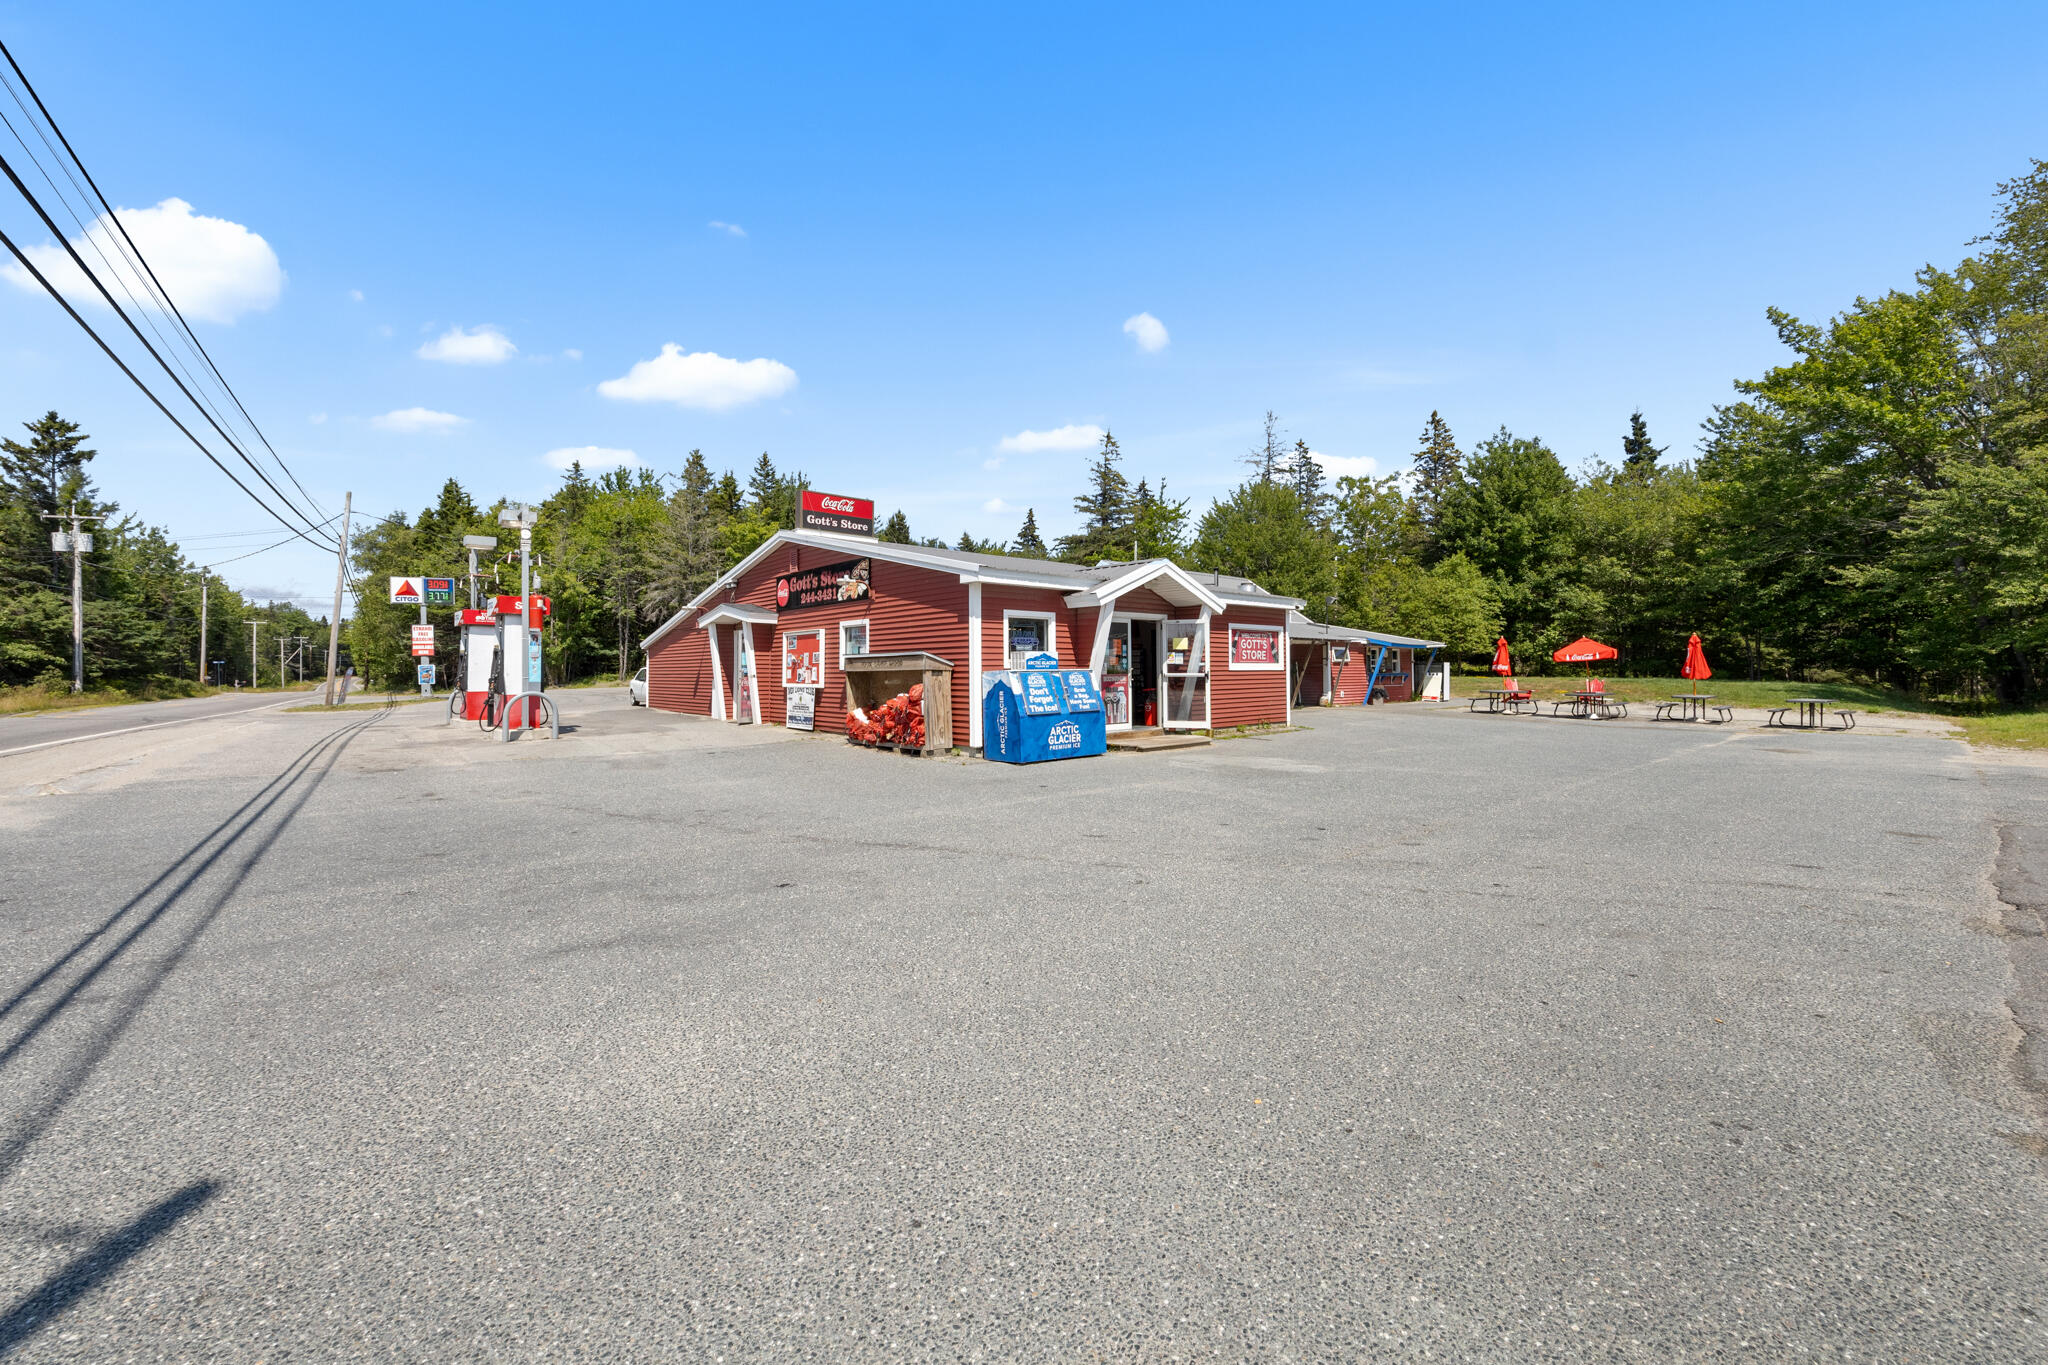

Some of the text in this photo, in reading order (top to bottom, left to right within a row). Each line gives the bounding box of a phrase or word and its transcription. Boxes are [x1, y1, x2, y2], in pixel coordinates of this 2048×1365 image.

[821, 496, 855, 513] Coca-Cola
[806, 514, 869, 531] Gott's Store
[789, 574, 818, 592] Gott's
[800, 587, 837, 604] 244-3431
[1241, 639, 1268, 649] GOTT'S
[1242, 650, 1267, 660] STORE
[1029, 688, 1049, 696] Don't
[1029, 695, 1054, 704] Forgot
[1045, 703, 1059, 711] Ice!
[1050, 725, 1079, 735] ARCTIC
[1048, 734, 1081, 745] GLACIER
